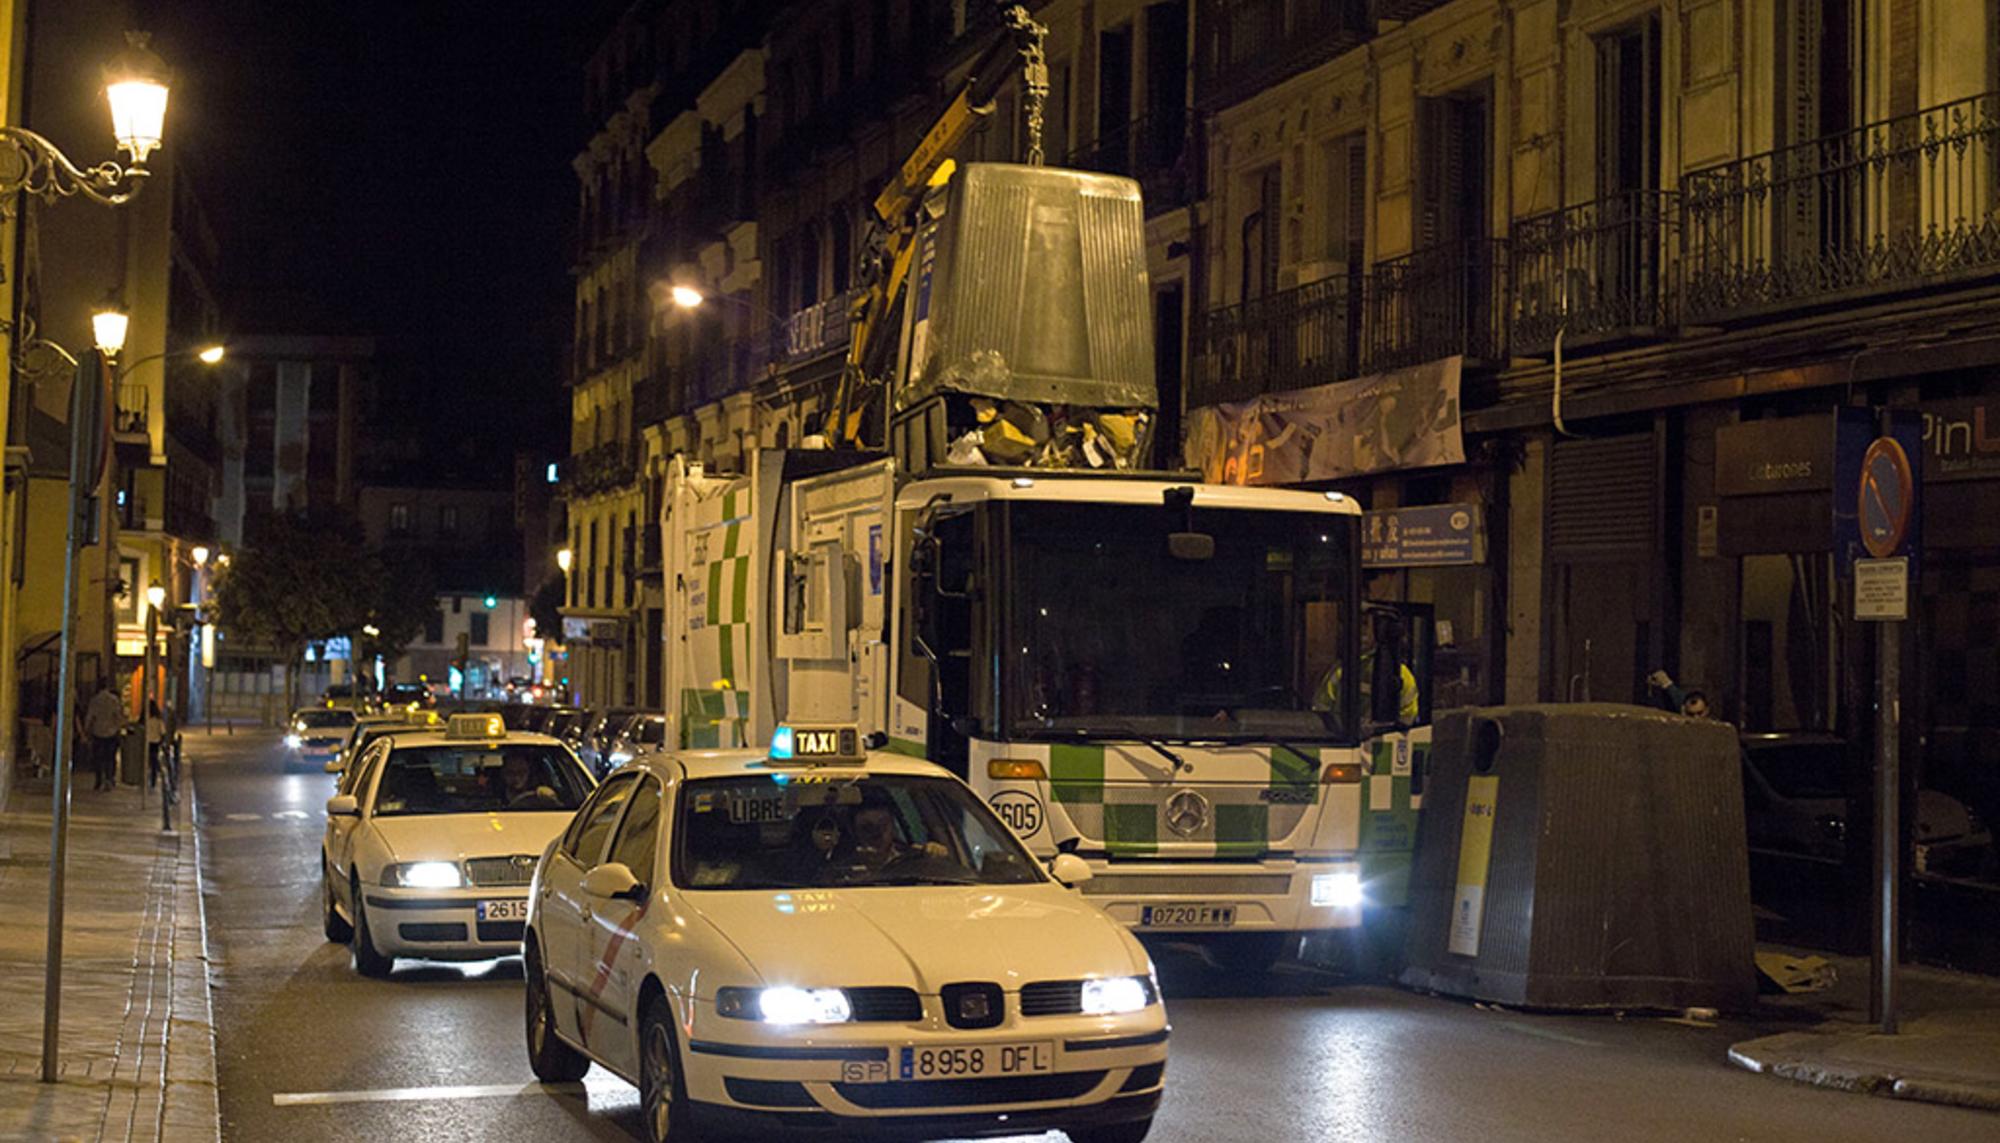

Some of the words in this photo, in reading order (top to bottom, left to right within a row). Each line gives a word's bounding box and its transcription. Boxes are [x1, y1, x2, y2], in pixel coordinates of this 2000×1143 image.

[796, 732, 837, 753] TAXI
[732, 798, 783, 822] LIBRE
[489, 901, 528, 918] 2615
[1153, 907, 1196, 923] 0720
[919, 1047, 985, 1075] 8958
[1001, 1045, 1048, 1073] DFL
[847, 1062, 885, 1081] SP
